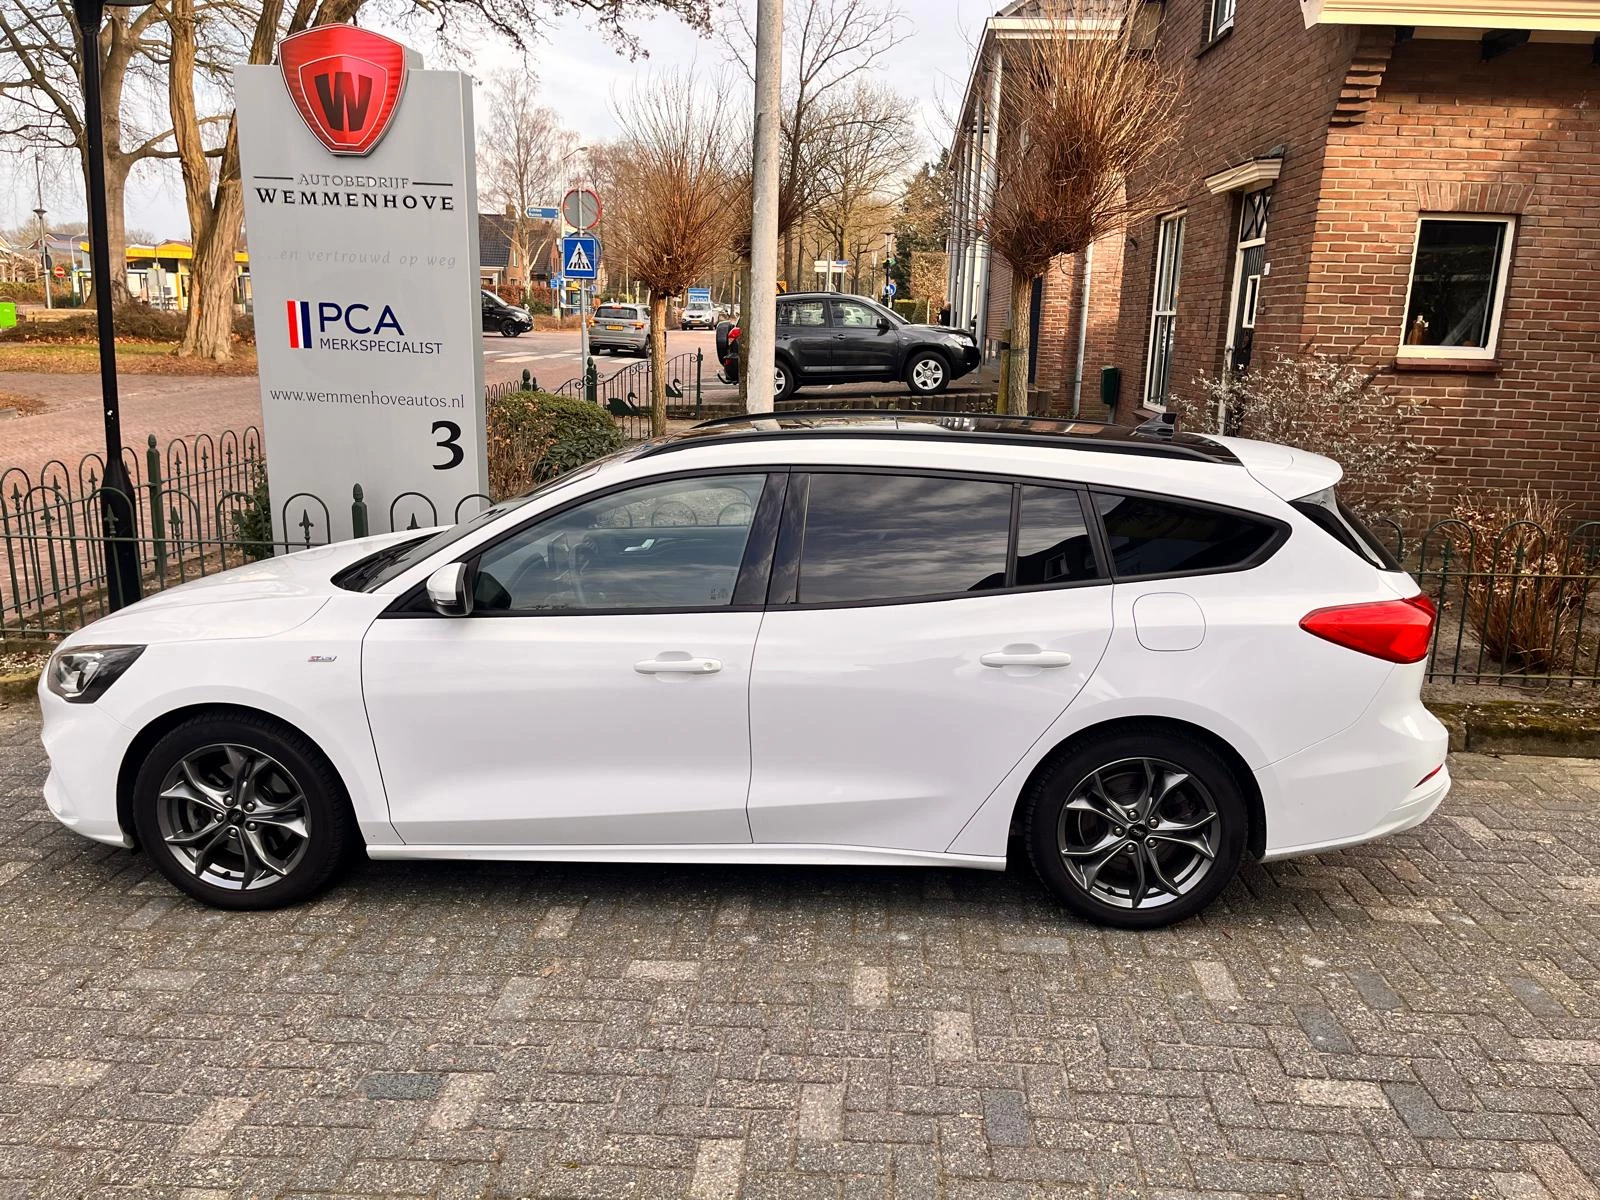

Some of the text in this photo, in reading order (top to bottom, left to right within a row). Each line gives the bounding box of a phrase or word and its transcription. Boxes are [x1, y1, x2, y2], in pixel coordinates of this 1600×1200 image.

[298, 173, 410, 190] AUTOBEDRIJF
[255, 186, 454, 211] WEMMENHOVE
[307, 249, 391, 265] vertrouwd
[399, 255, 418, 268] op
[427, 255, 456, 270] weg
[318, 301, 405, 336] PCA
[319, 338, 443, 355] MERKSPECIALIST
[269, 389, 465, 409] www.wemmenhoveautos.nl
[431, 420, 465, 471] 3
